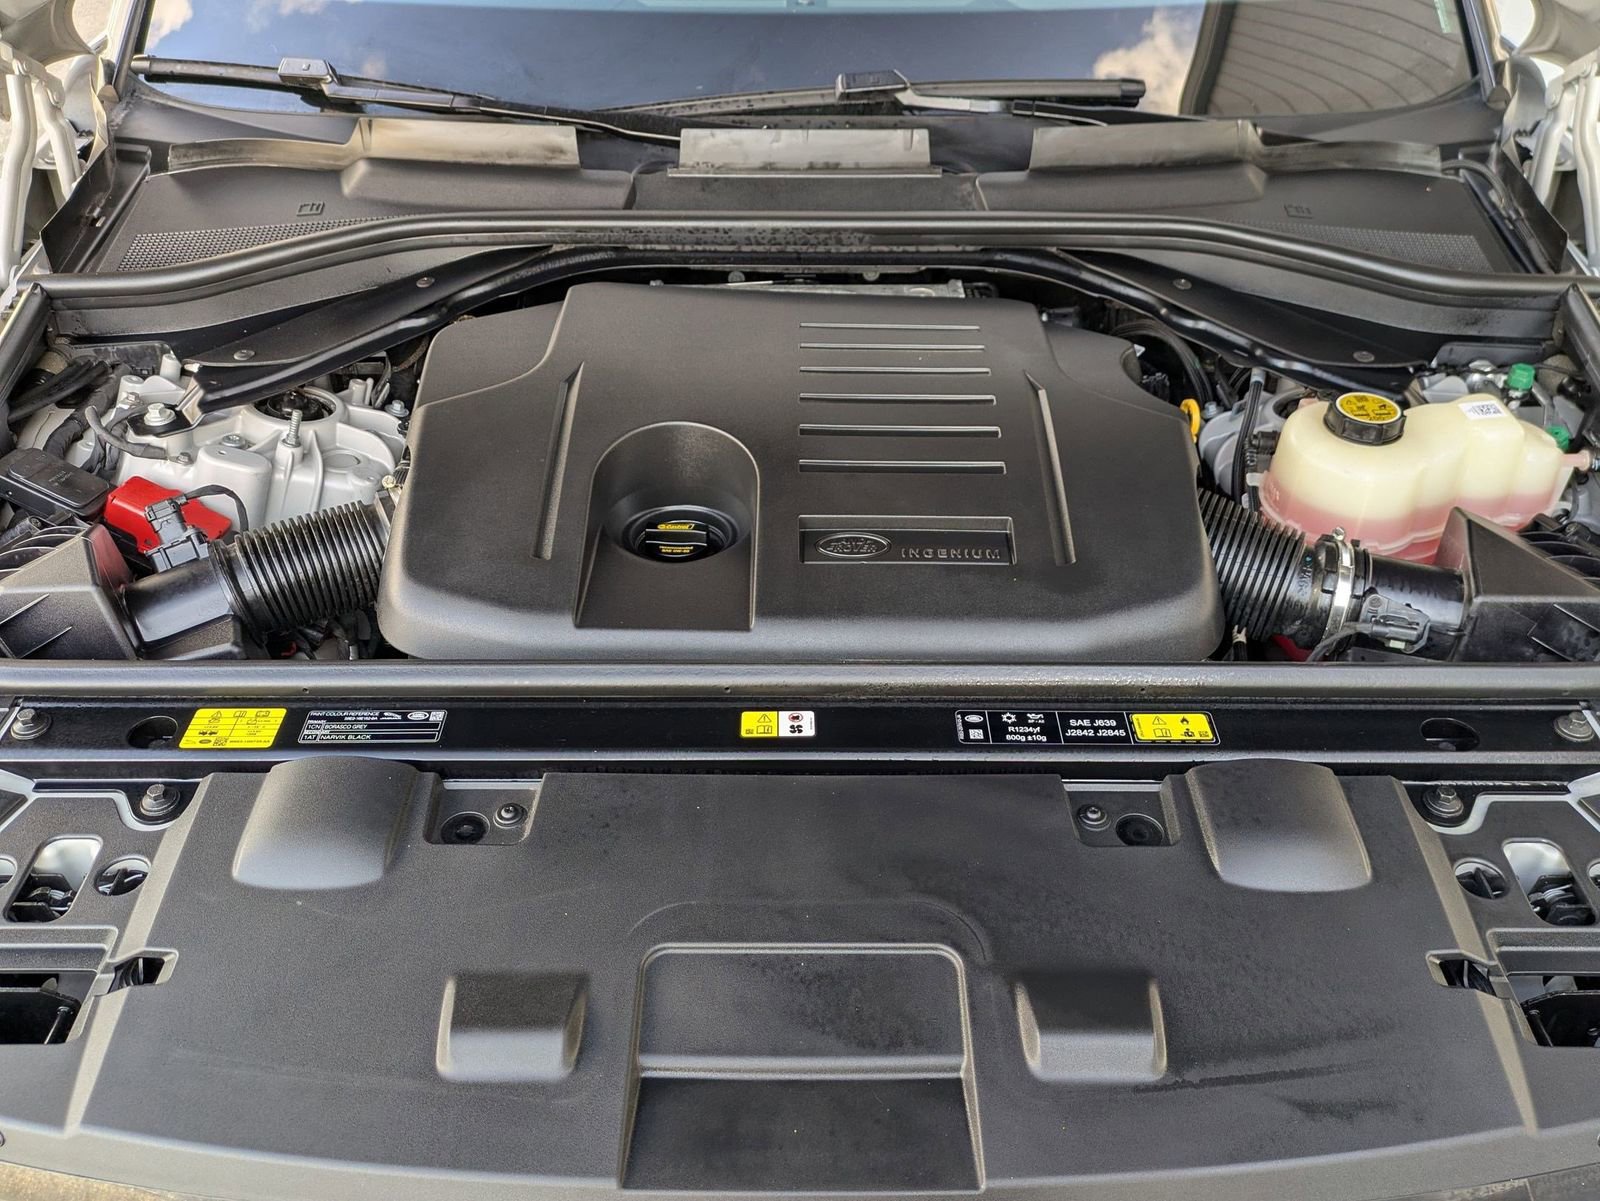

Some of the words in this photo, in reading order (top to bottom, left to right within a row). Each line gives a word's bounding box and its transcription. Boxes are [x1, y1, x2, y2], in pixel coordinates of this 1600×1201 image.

[901, 548, 1000, 559] INGENIUM
[1069, 719, 1091, 727] SAE
[1093, 719, 1117, 727] J639
[1008, 726, 1041, 734] R1234yf
[1065, 728, 1095, 737] J2842
[1096, 728, 1126, 737] J2845
[1005, 734, 1026, 742] 800g
